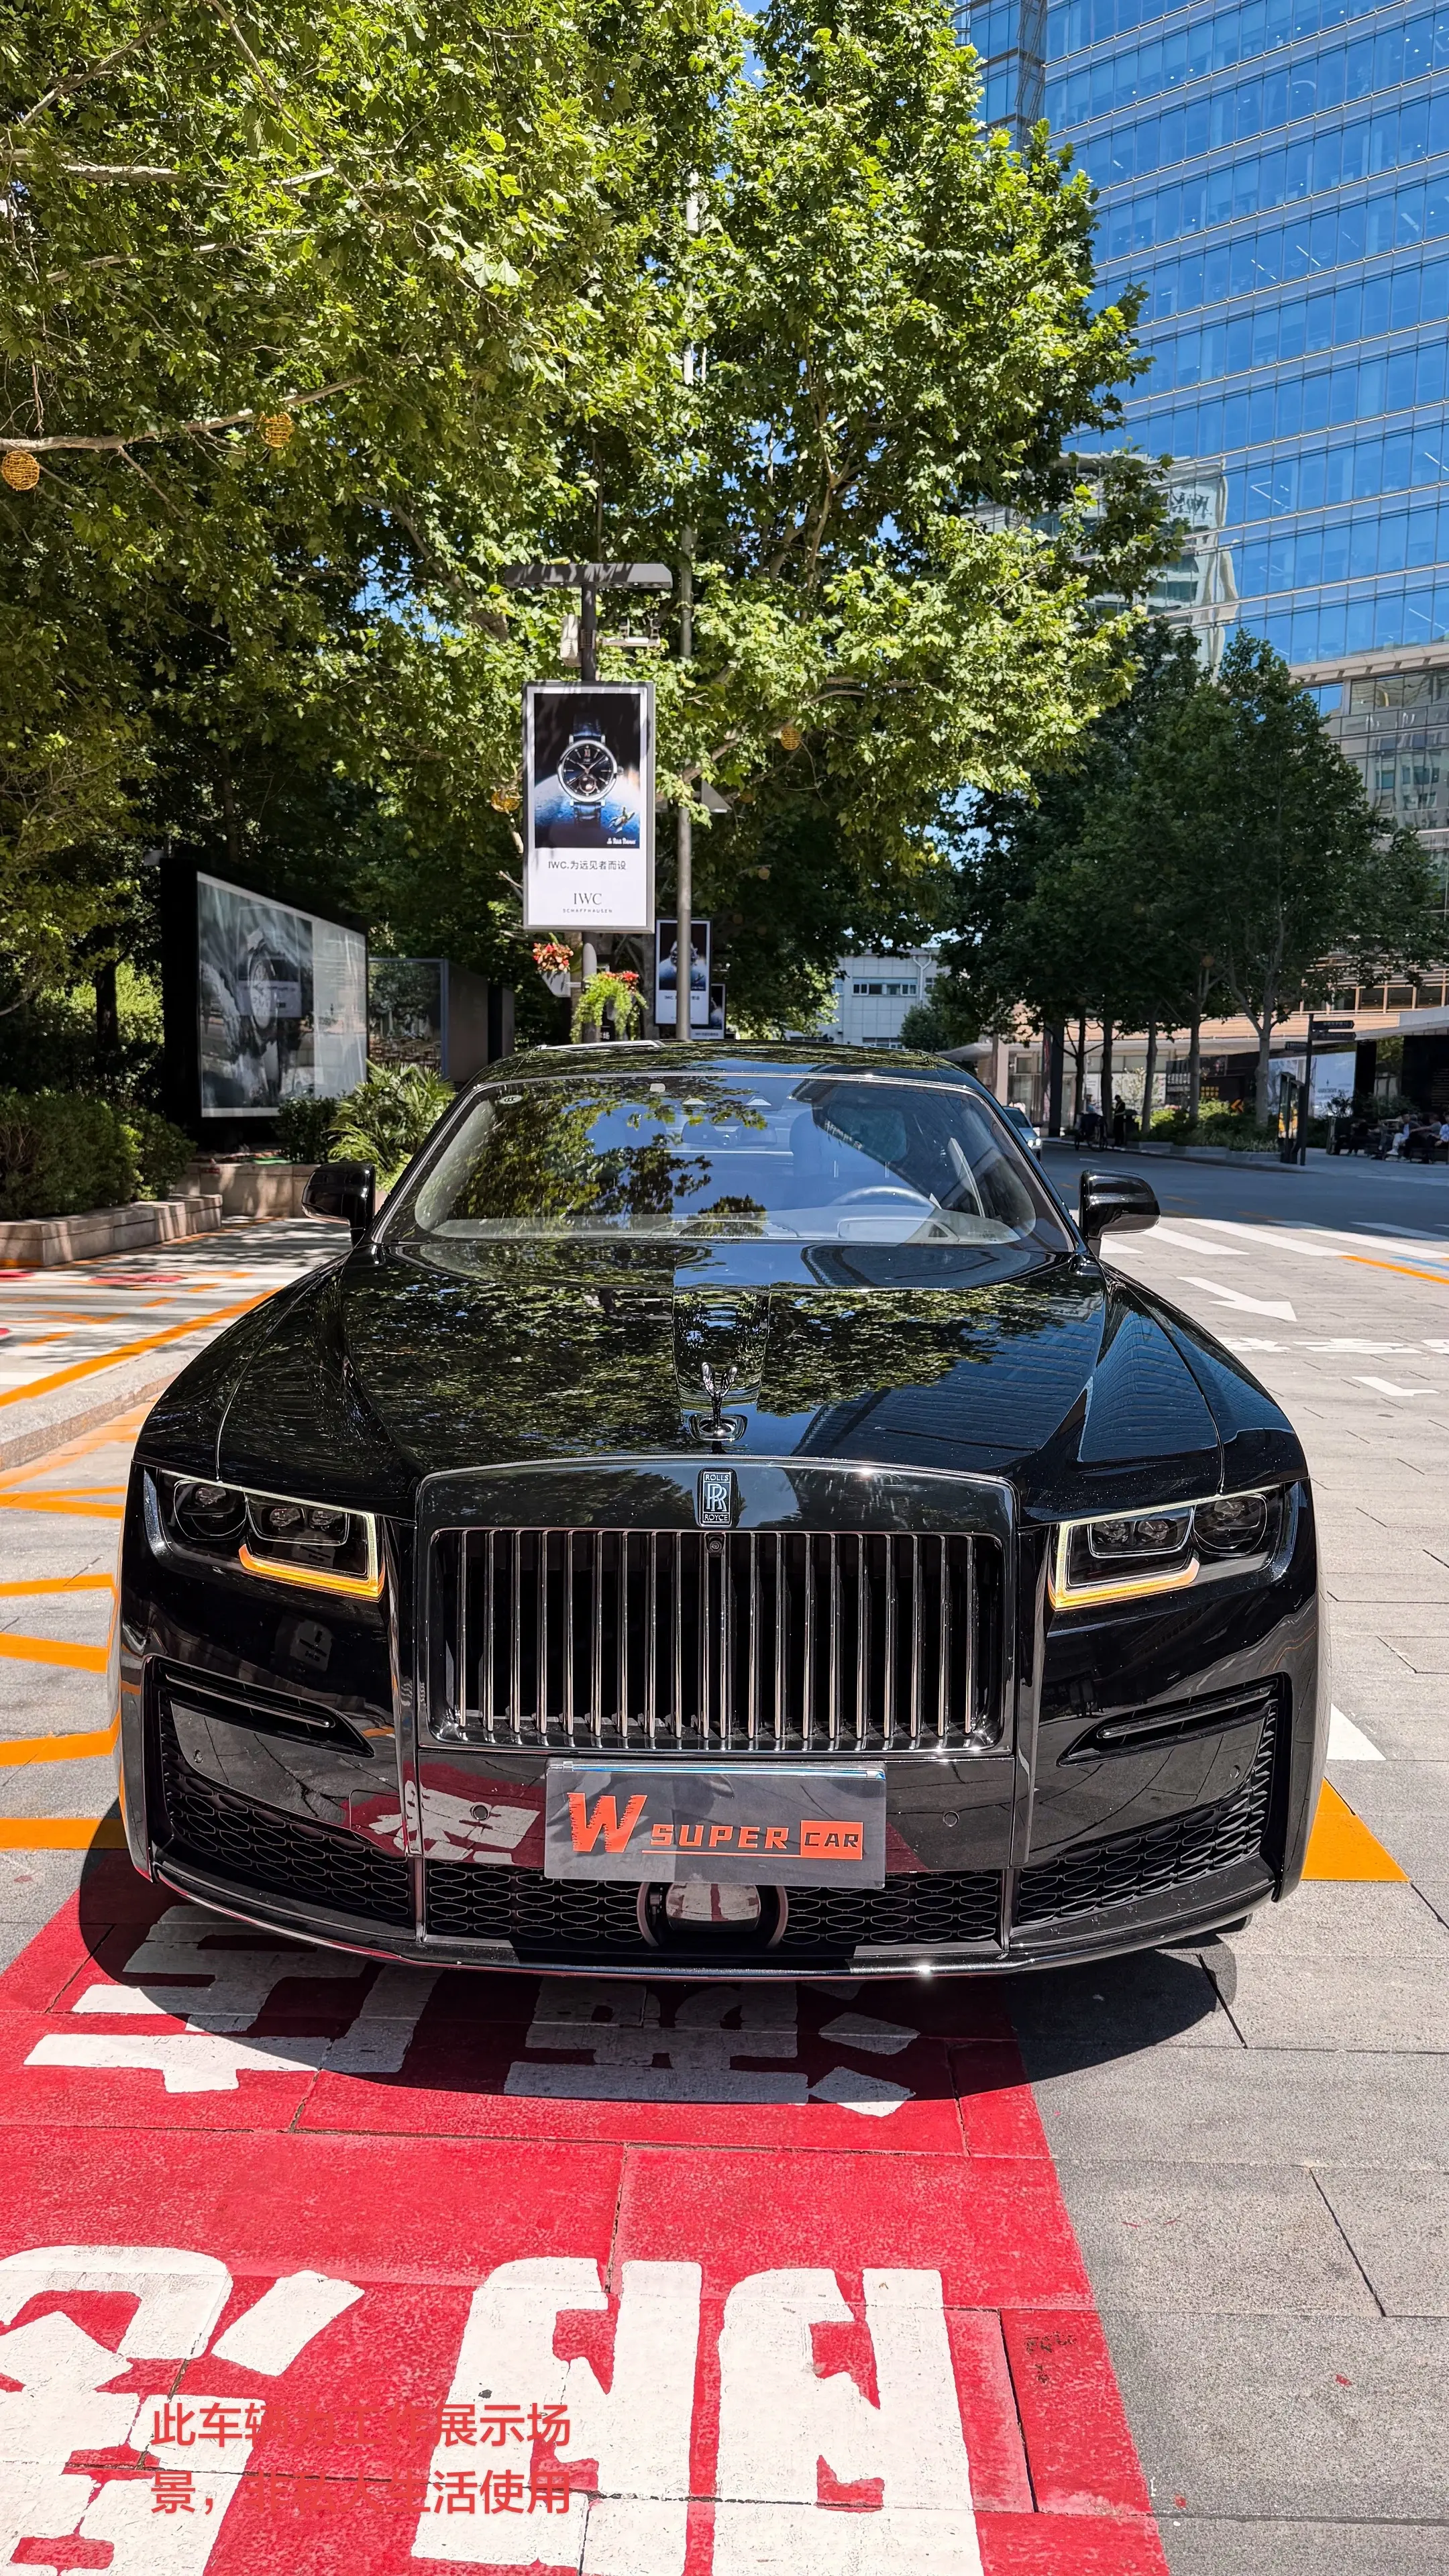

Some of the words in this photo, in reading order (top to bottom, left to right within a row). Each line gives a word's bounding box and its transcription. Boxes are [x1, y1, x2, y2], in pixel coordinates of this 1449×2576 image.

[547, 860, 627, 870] IWC.为远见者而设
[574, 892, 602, 905] IWC
[567, 1792, 648, 1854] W
[649, 1823, 790, 1849] SUPER
[804, 1831, 859, 1848] CAR
